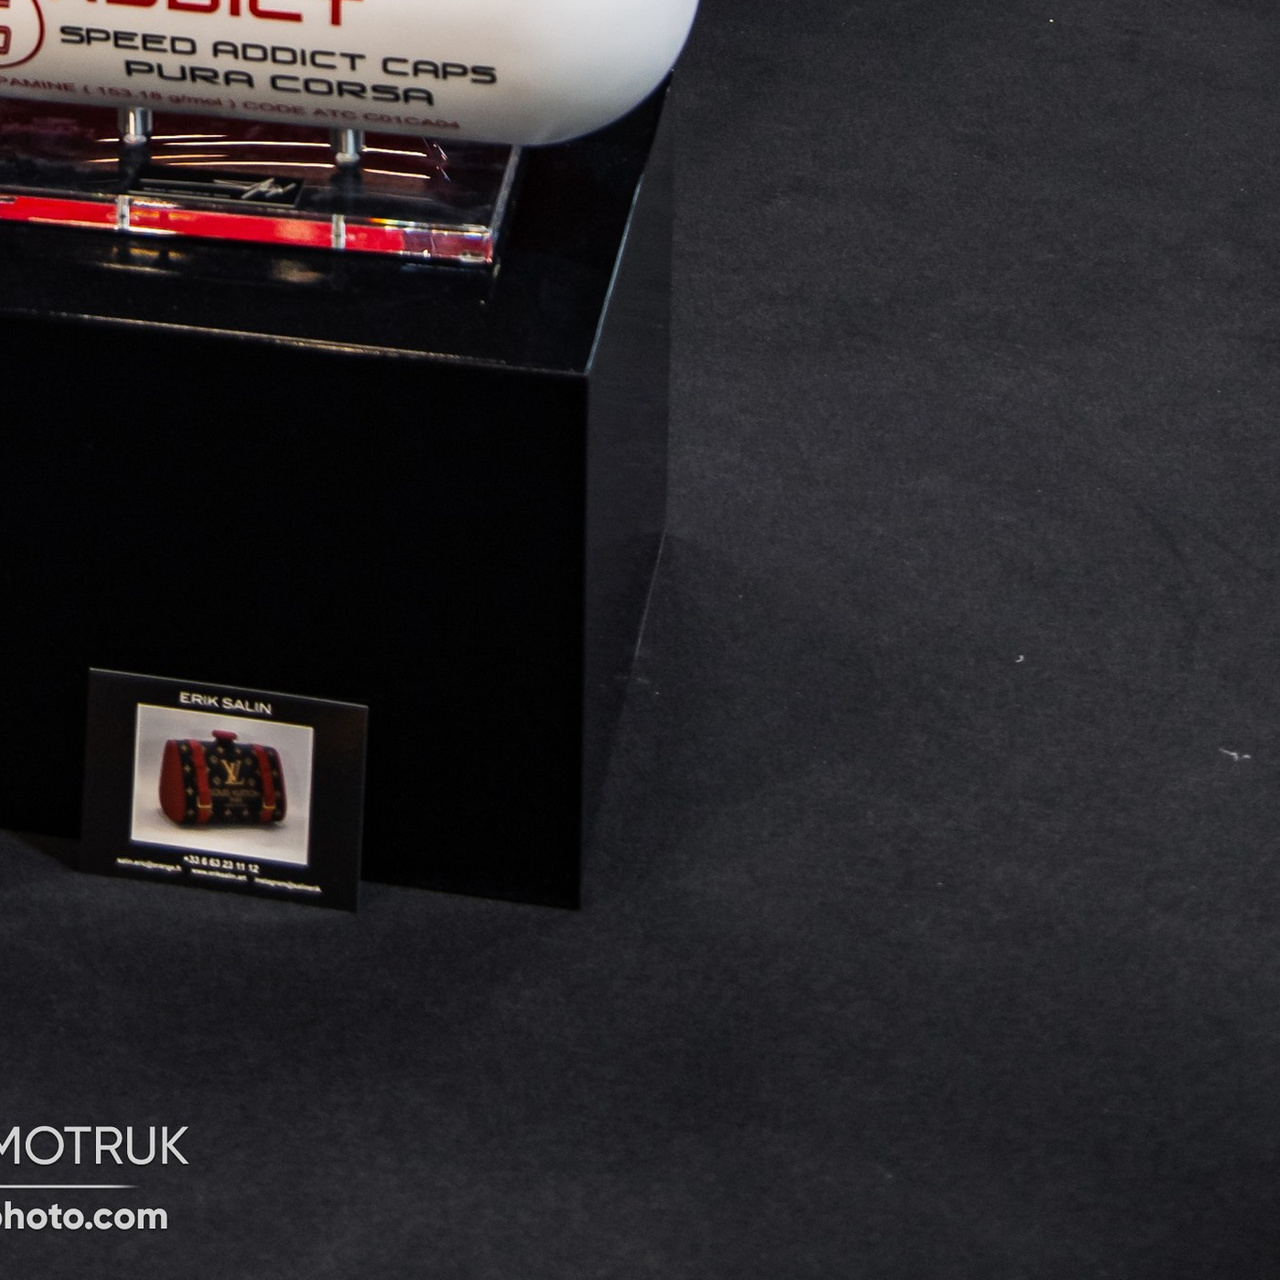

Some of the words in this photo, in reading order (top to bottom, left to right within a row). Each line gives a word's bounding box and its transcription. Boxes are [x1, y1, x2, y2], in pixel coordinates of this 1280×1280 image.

[59, 25, 198, 57] SPEED
[211, 40, 366, 71] ADDICT
[383, 53, 498, 85] CAPS
[125, 59, 255, 90] PURA
[270, 73, 434, 106] CORSA
[97, 86, 163, 101] 153.18
[242, 100, 307, 115] CODE
[312, 109, 357, 121] ATC
[179, 691, 220, 708] ERIK
[222, 697, 273, 716] SALIN
